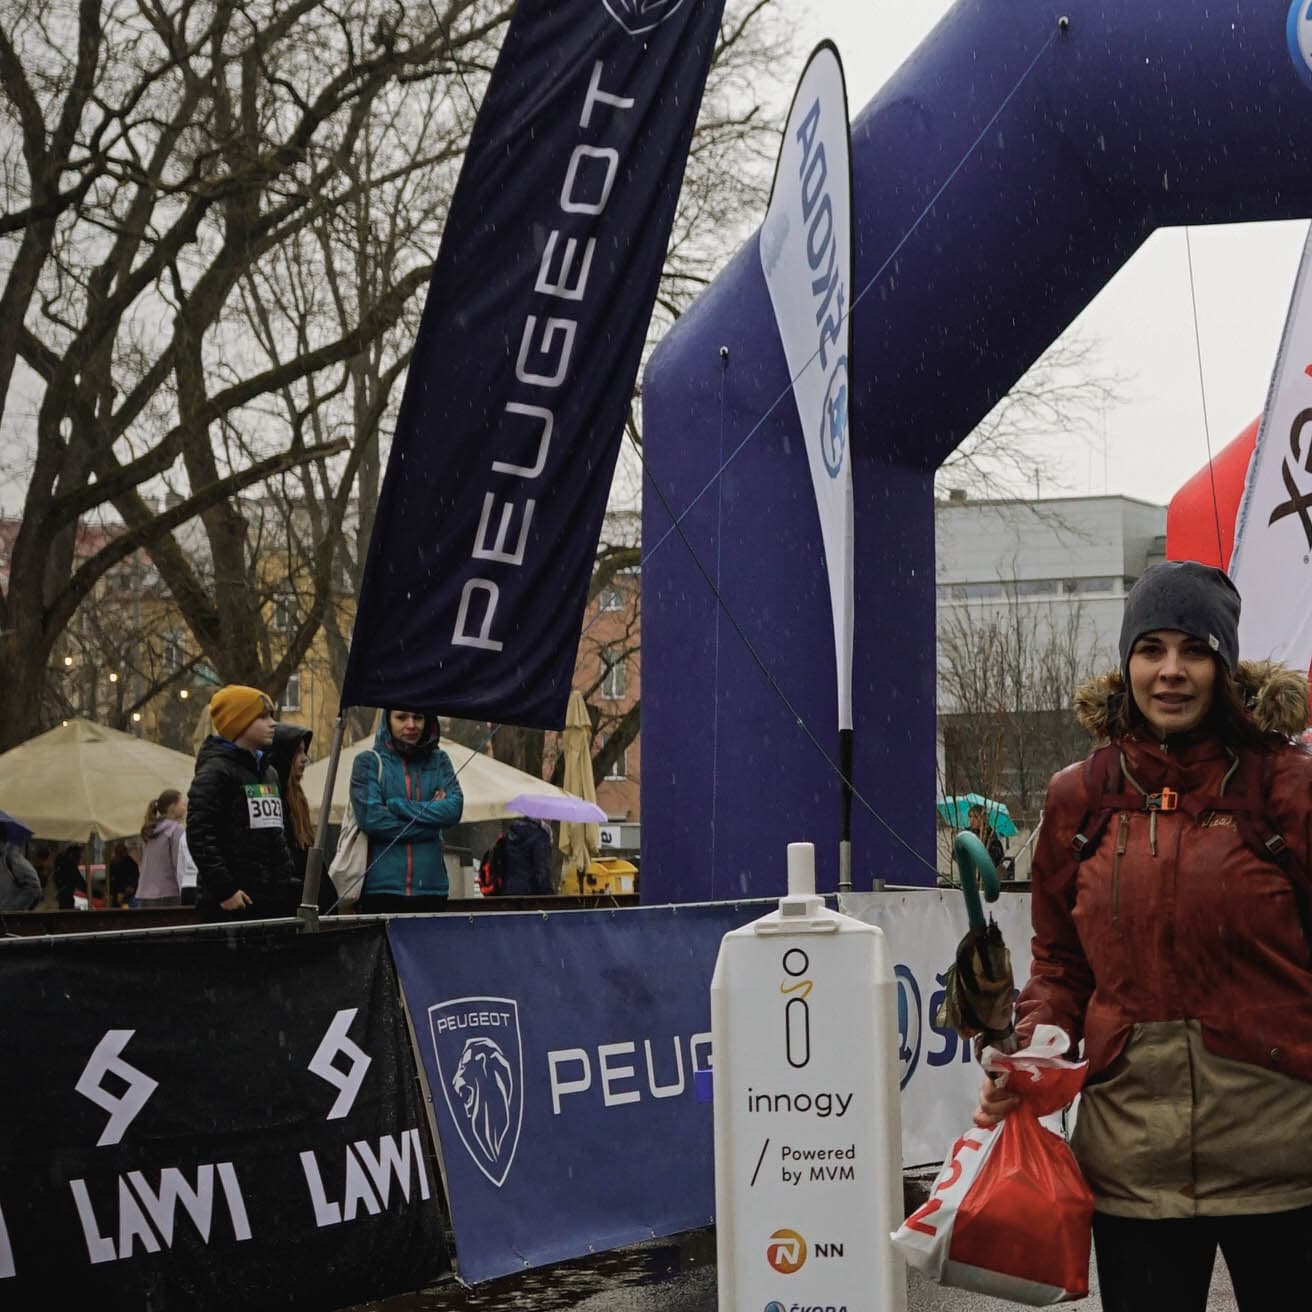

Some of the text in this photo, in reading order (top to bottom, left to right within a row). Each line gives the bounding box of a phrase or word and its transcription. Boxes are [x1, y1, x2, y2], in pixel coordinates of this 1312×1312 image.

[452, 60, 636, 653] PEUGEOT
[437, 1012, 510, 1034] PEUGEOT
[748, 1088, 853, 1118] innogy
[781, 1144, 856, 1161] Powered
[299, 1128, 431, 1228] LAWI
[782, 1166, 855, 1186] by MVM
[69, 1162, 253, 1265] LAWI
[815, 1243, 845, 1259] NN
